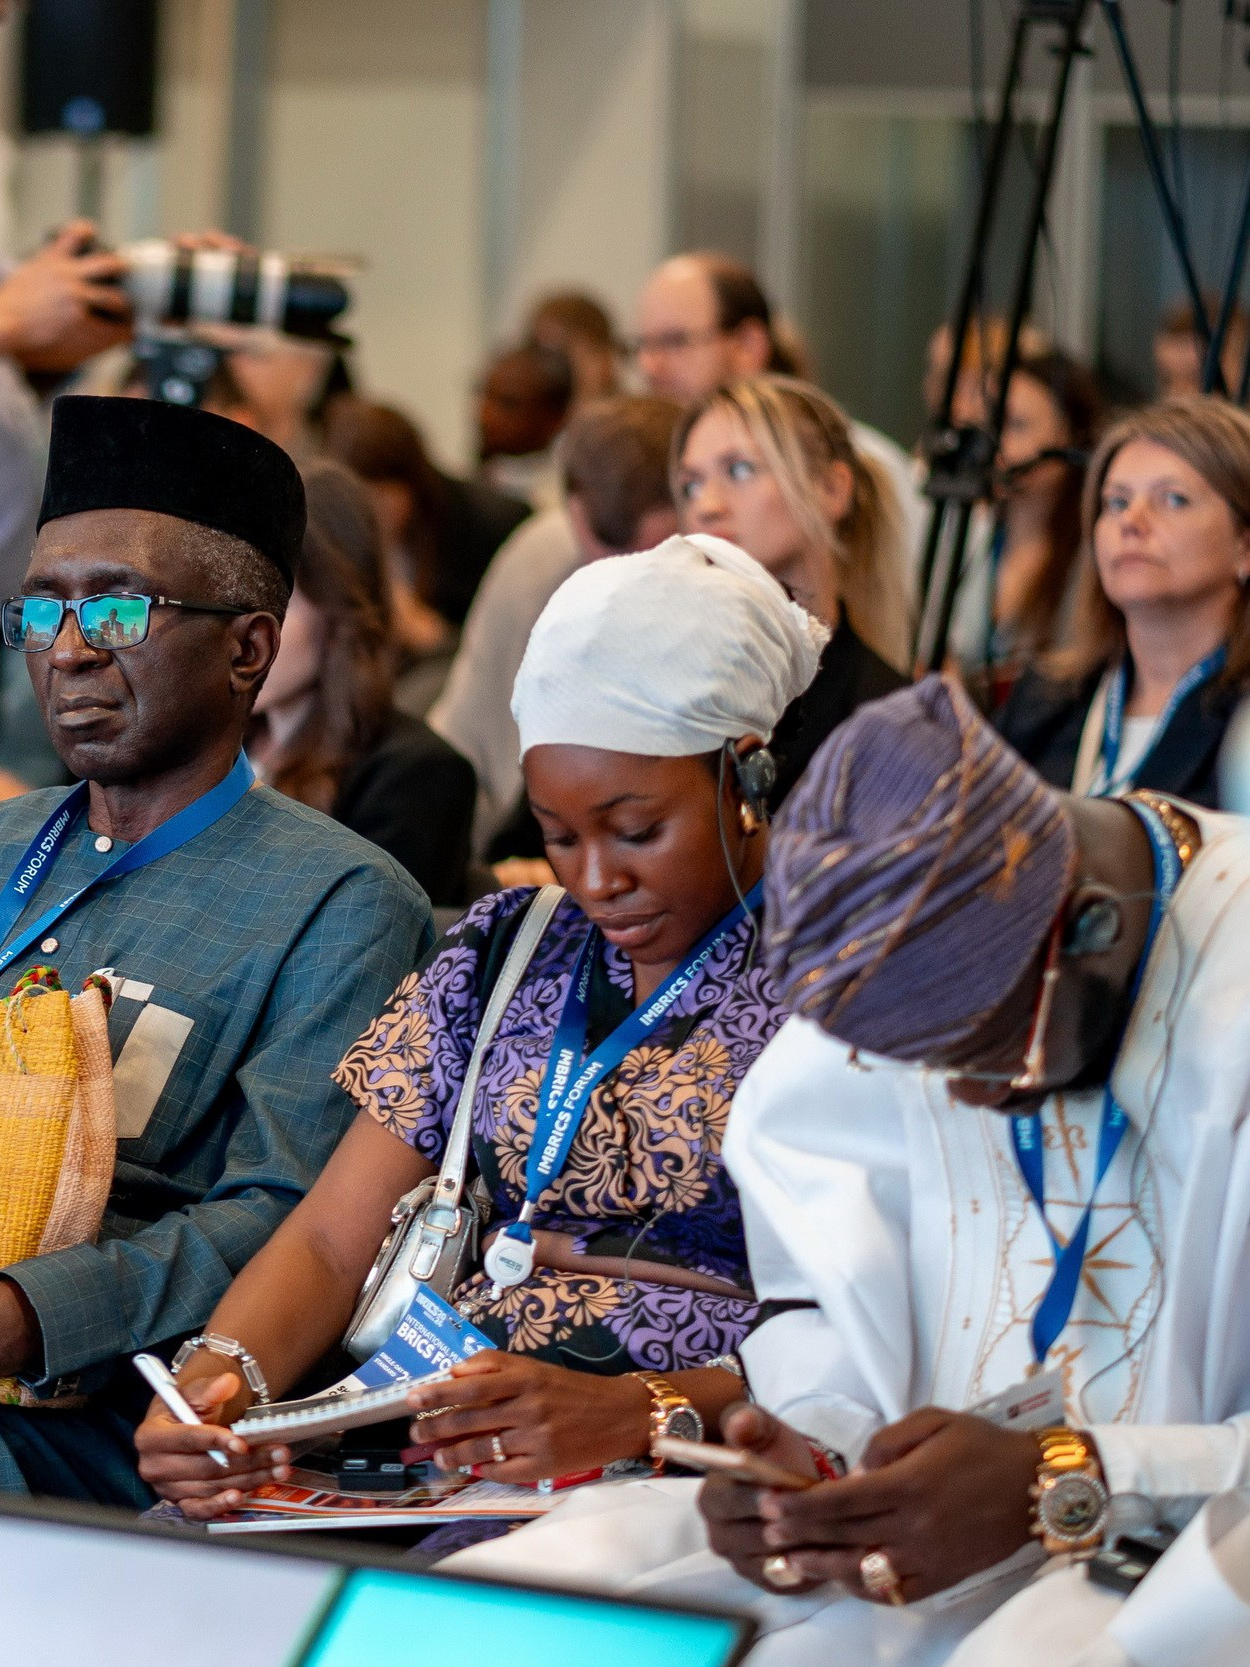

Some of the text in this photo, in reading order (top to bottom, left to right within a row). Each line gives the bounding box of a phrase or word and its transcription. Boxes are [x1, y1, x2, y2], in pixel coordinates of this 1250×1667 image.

[14, 810, 70, 894] IMBRICS FORUM
[639, 975, 689, 1027] IMBRICS
[547, 1048, 574, 1111] IMBRICS
[537, 1061, 604, 1175] IMBRICS FORUM
[396, 1321, 435, 1359] BRICS
[405, 1314, 452, 1356] INTERNATIONAL
[373, 1357, 397, 1377] STANDARD
